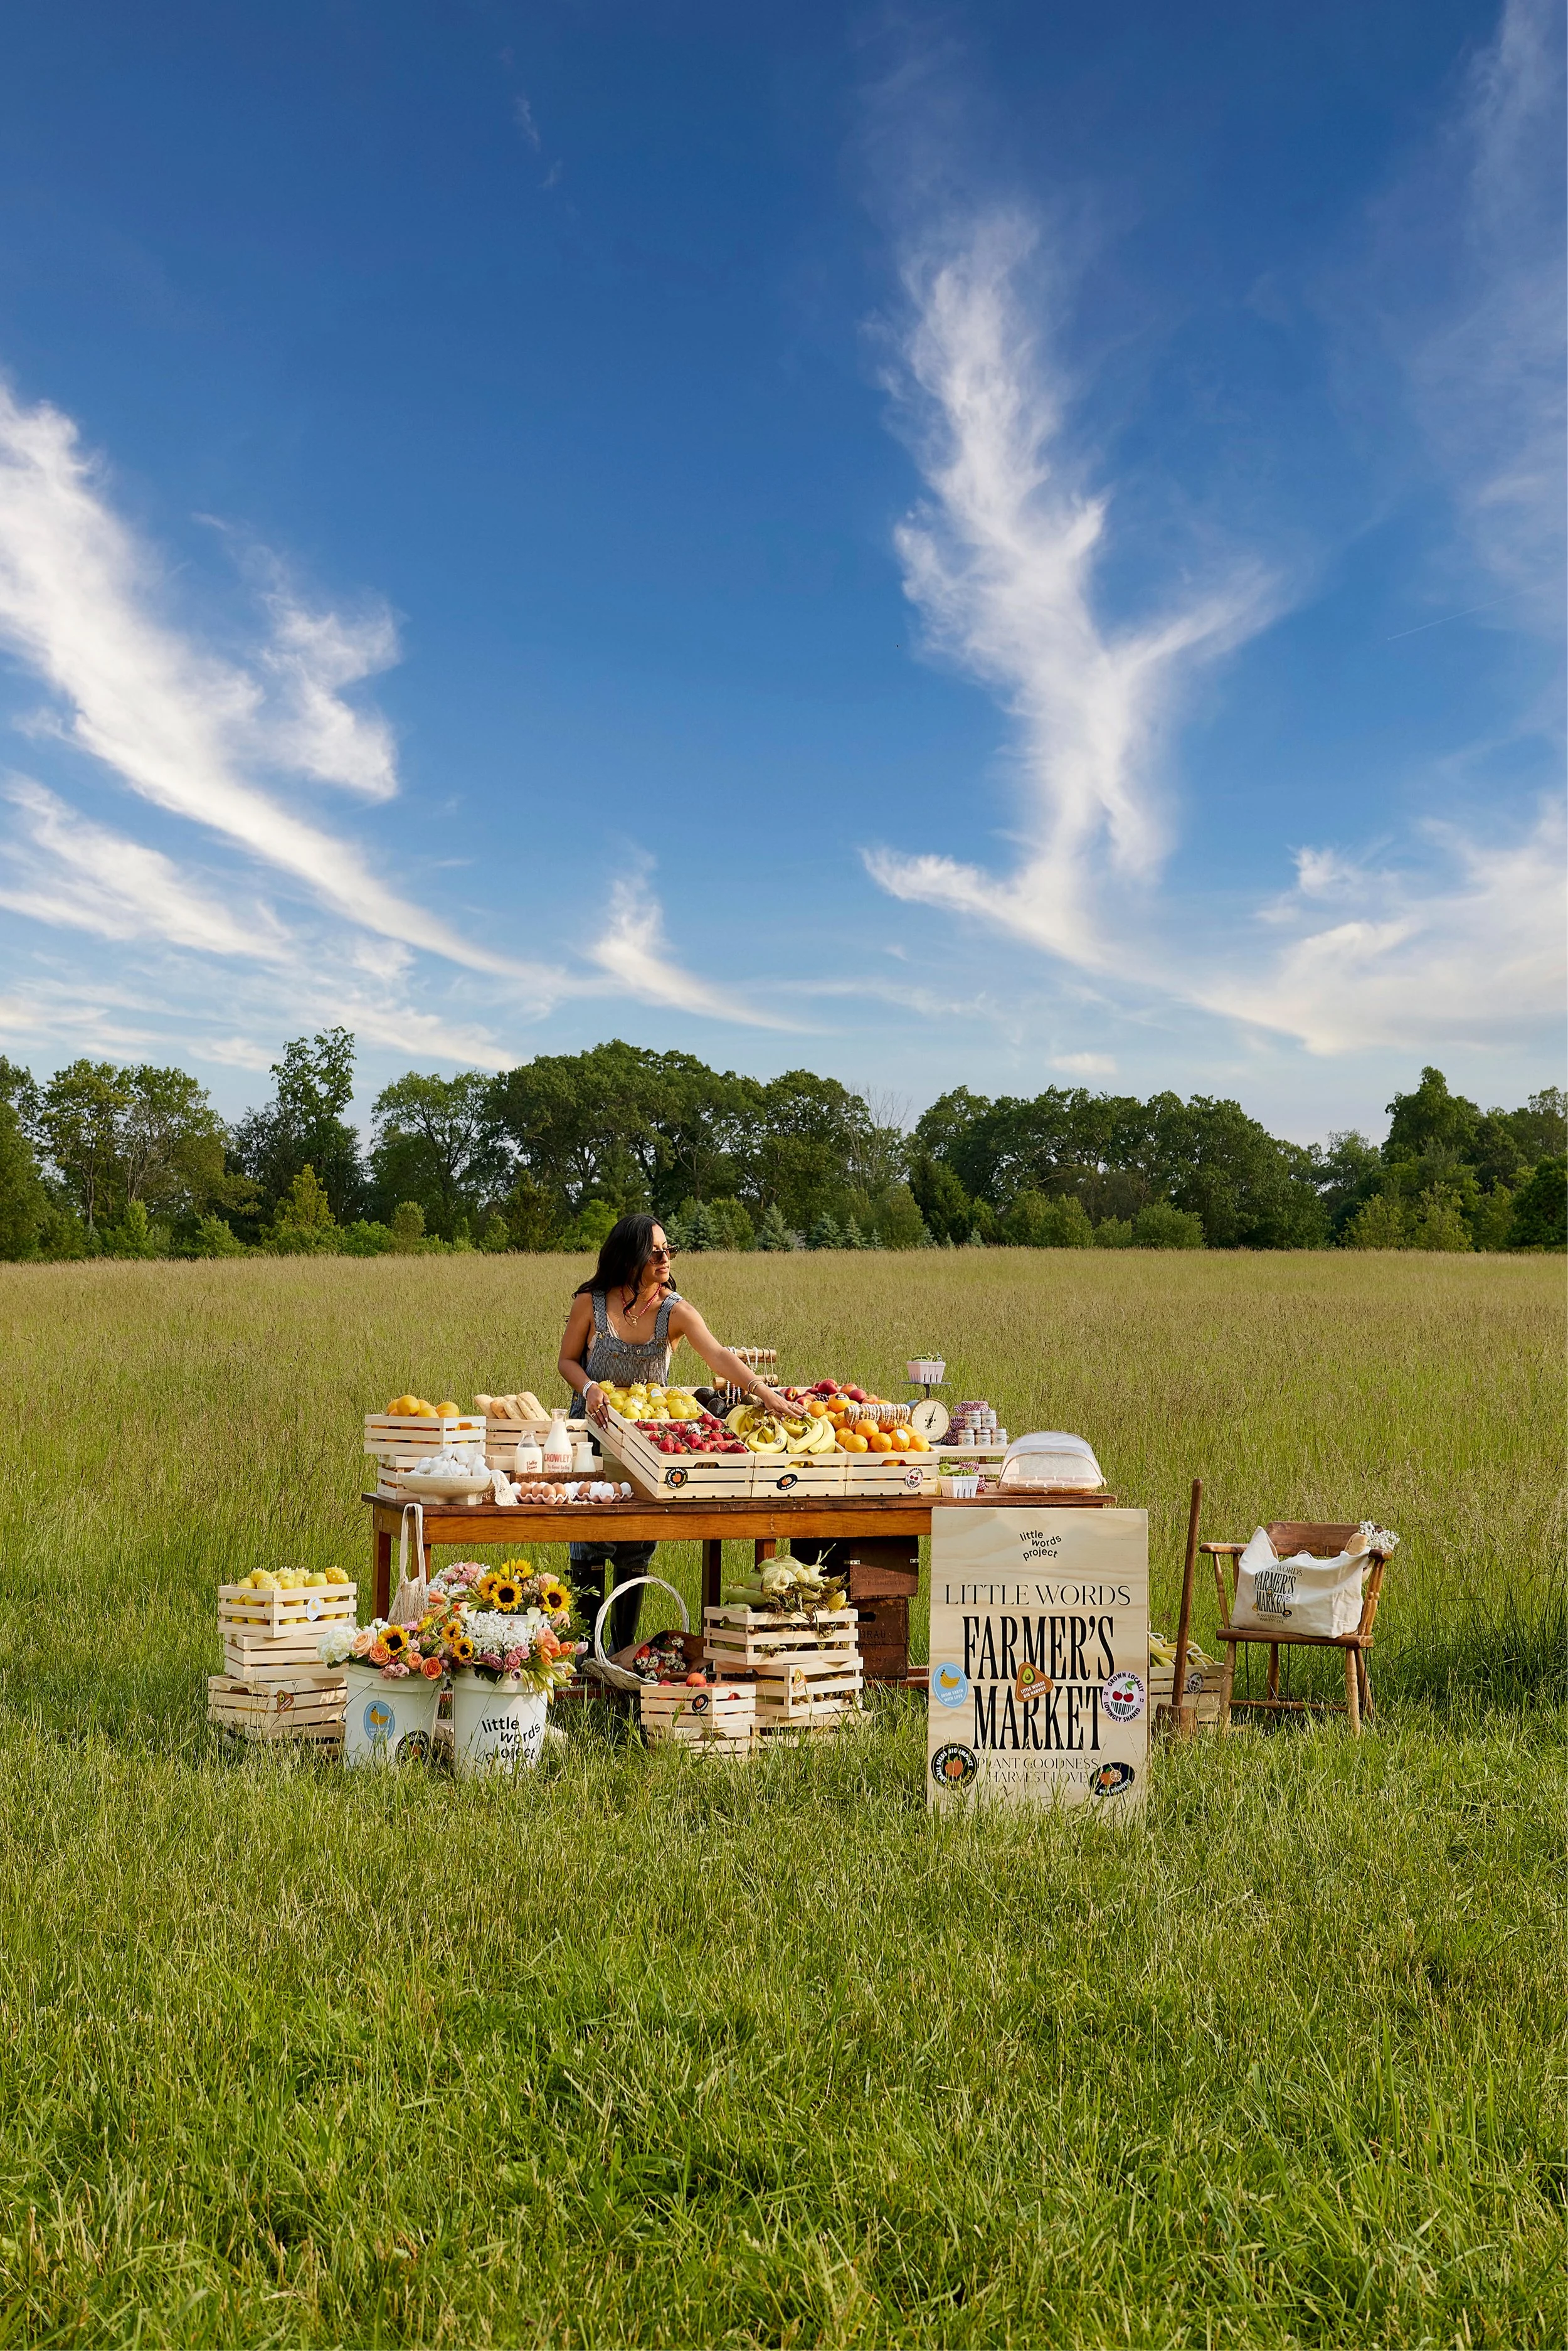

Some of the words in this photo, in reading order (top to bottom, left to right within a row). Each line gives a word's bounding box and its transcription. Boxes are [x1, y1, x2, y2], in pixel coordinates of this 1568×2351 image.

[1019, 1530, 1044, 1541] little
[1032, 1536, 1062, 1547] words
[1022, 1547, 1058, 1561] project
[1276, 1564, 1303, 1576] WORDS
[1254, 1570, 1296, 1594] FARMER'S
[945, 1584, 1030, 1605] LITTLE
[1035, 1585, 1131, 1605] WORDS
[962, 1615, 1115, 1680] FARMER'S
[1030, 1685, 1047, 1696] HARVEST
[1032, 1680, 1045, 1689] WORDS
[1107, 1672, 1126, 1687] GROWN
[1128, 1672, 1145, 1692] LOCALLY
[973, 1685, 1104, 1750] MARKET
[1104, 1701, 1122, 1722] LOVINGLY
[1123, 1707, 1141, 1722] SHARED
[482, 1716, 519, 1733] little
[501, 1723, 541, 1743] words
[936, 1751, 948, 1766] SEEDS
[977, 1758, 1020, 1769] PLANT
[1024, 1758, 1098, 1770] GOODNESS
[935, 1766, 947, 1783] SMALL
